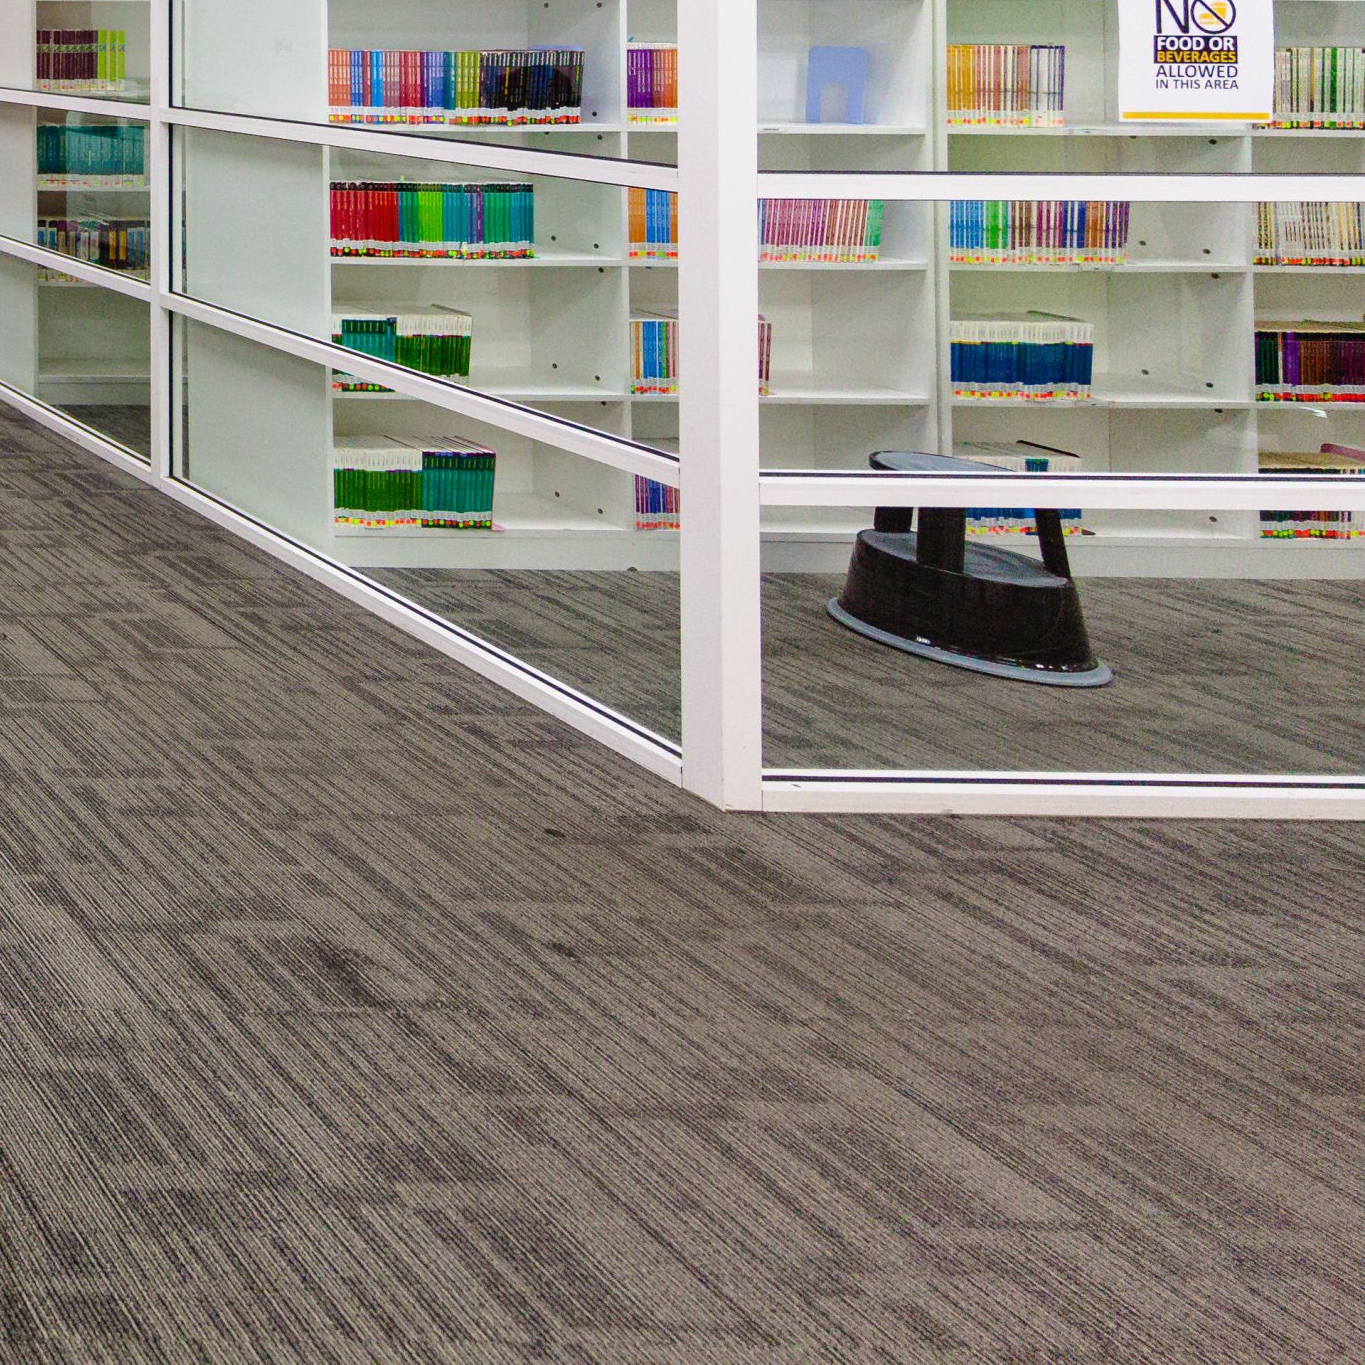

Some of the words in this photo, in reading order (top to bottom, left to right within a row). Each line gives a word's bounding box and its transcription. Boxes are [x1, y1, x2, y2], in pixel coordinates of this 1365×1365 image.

[1157, 37, 1205, 51] FOOD
[1209, 37, 1235, 51] OR
[1157, 51, 1237, 63] BEVERAGES
[1156, 65, 1239, 78] ALLOWED
[1156, 79, 1169, 89] IN
[1173, 79, 1201, 89] THIS
[1204, 79, 1239, 89] AREA
